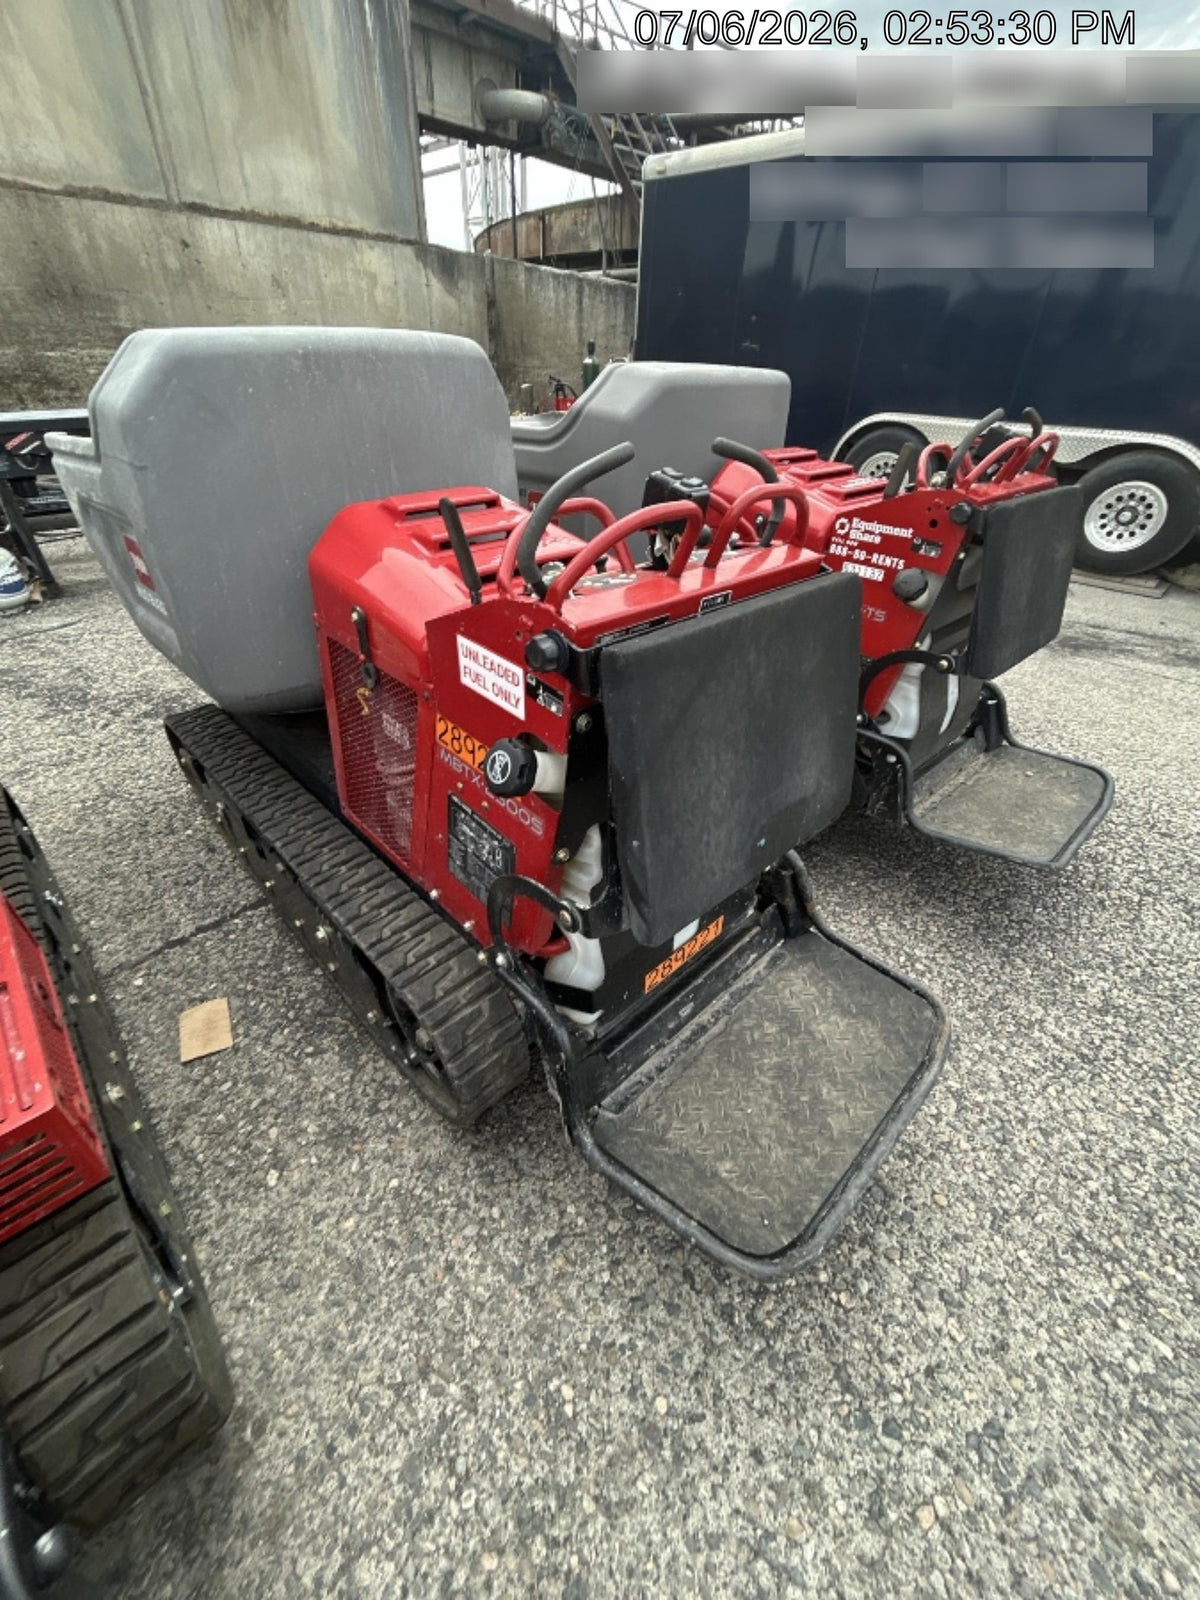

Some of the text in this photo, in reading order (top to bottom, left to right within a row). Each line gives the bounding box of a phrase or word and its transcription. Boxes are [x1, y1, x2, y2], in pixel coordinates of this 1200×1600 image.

[849, 530, 882, 545] Share
[852, 517, 914, 539] Equipment
[461, 642, 520, 688] UNLEADED
[463, 665, 490, 693] FUEL
[492, 681, 521, 710] ONLY
[438, 716, 488, 770] 2892
[646, 920, 720, 992] 289221
